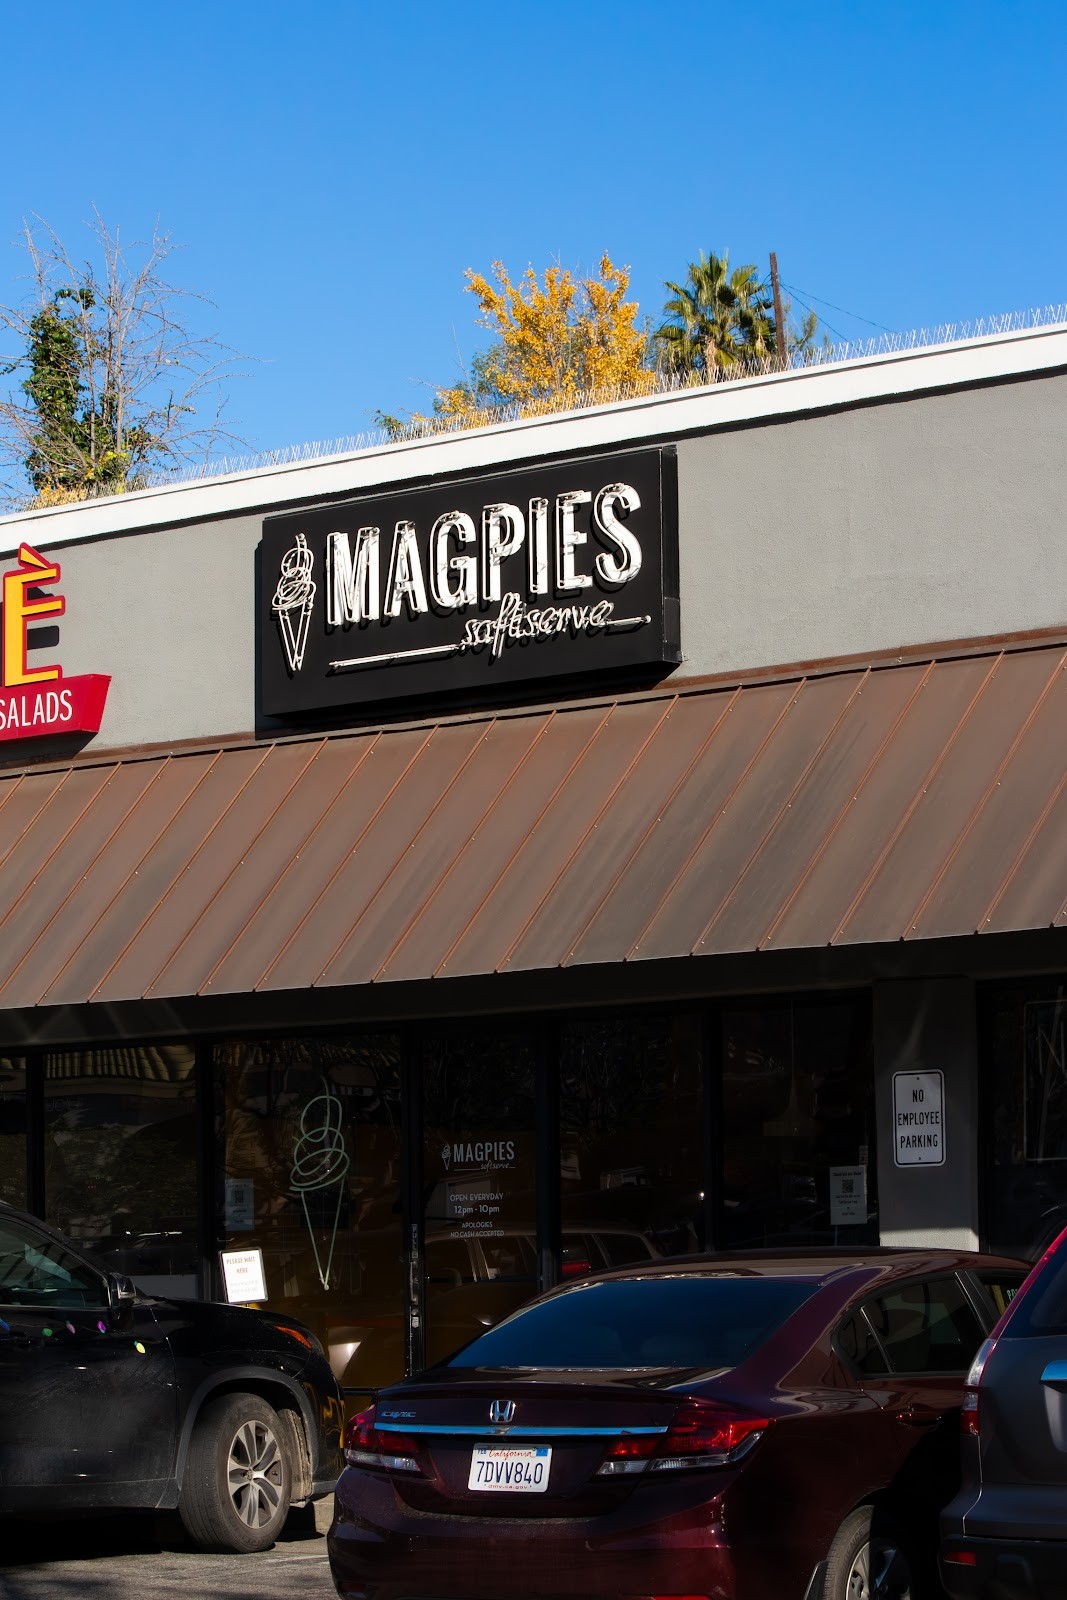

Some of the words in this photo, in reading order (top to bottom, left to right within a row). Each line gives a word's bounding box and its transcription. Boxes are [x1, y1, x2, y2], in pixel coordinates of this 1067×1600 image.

[326, 482, 642, 626] MAGPIES
[912, 1089, 924, 1103] NO
[897, 1111, 940, 1126] EMPLOYEE
[900, 1134, 938, 1149] PARKING
[453, 1141, 515, 1163] MAGPIES
[449, 1194, 468, 1202] OPEN
[469, 1192, 504, 1201] EVERYDAY
[454, 1205, 474, 1216] 12pm
[479, 1204, 500, 1215] 10pm
[461, 1221, 493, 1229] APOLOGIES
[488, 1447, 535, 1461] California
[476, 1461, 544, 1484] 7DVV840
